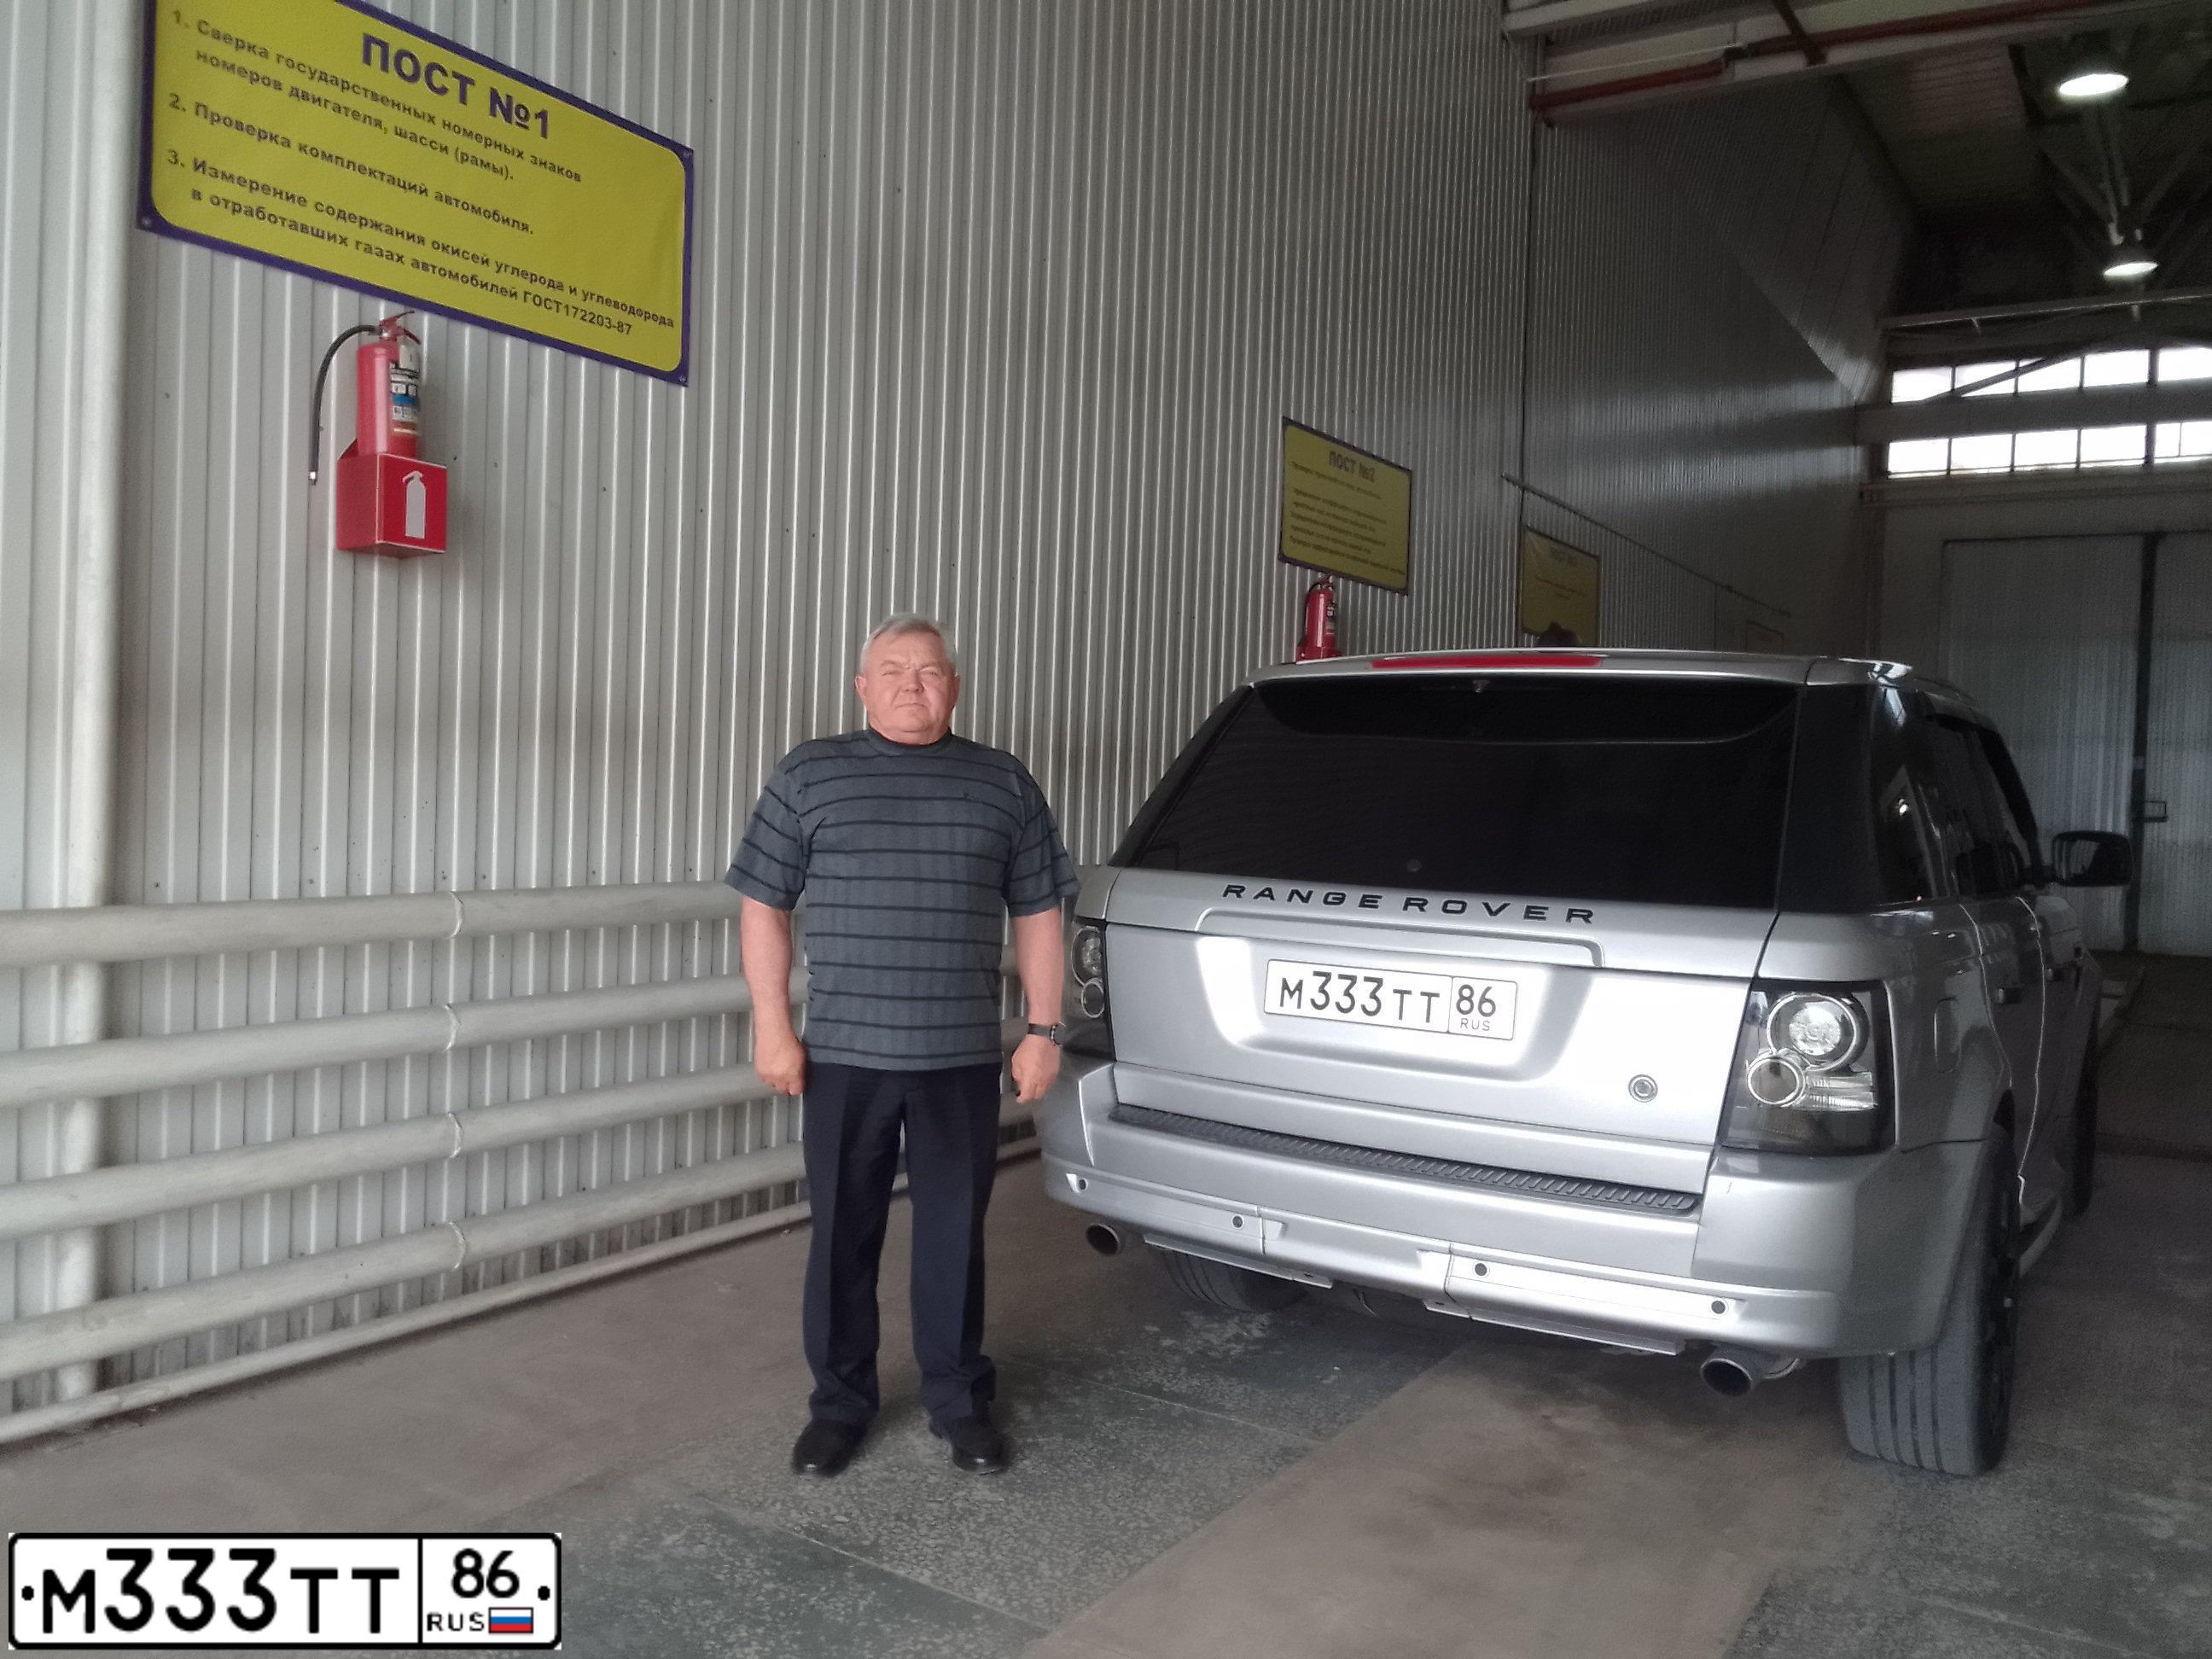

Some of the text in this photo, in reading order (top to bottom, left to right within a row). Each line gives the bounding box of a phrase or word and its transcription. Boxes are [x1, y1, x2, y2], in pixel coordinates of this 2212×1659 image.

[173, 9, 581, 183] 1. Сверка государственных номерных знаков
[196, 49, 513, 180] номеров двигателя, шасси (рамы).
[362, 33, 549, 139] ПОСТ №1
[169, 92, 533, 235] 2. Проверка комплектаций автомобиля.
[168, 148, 674, 329] 3. Измерение содержания окисей углерода и углеводорода
[191, 188, 202, 201] в
[210, 195, 348, 247] отработавших
[354, 239, 405, 265] газах
[410, 258, 518, 300] автомобилей
[1222, 883, 1594, 924] RANGE ROVER
[1455, 984, 1497, 1018] 86
[1460, 1018, 1491, 1032] RUS
